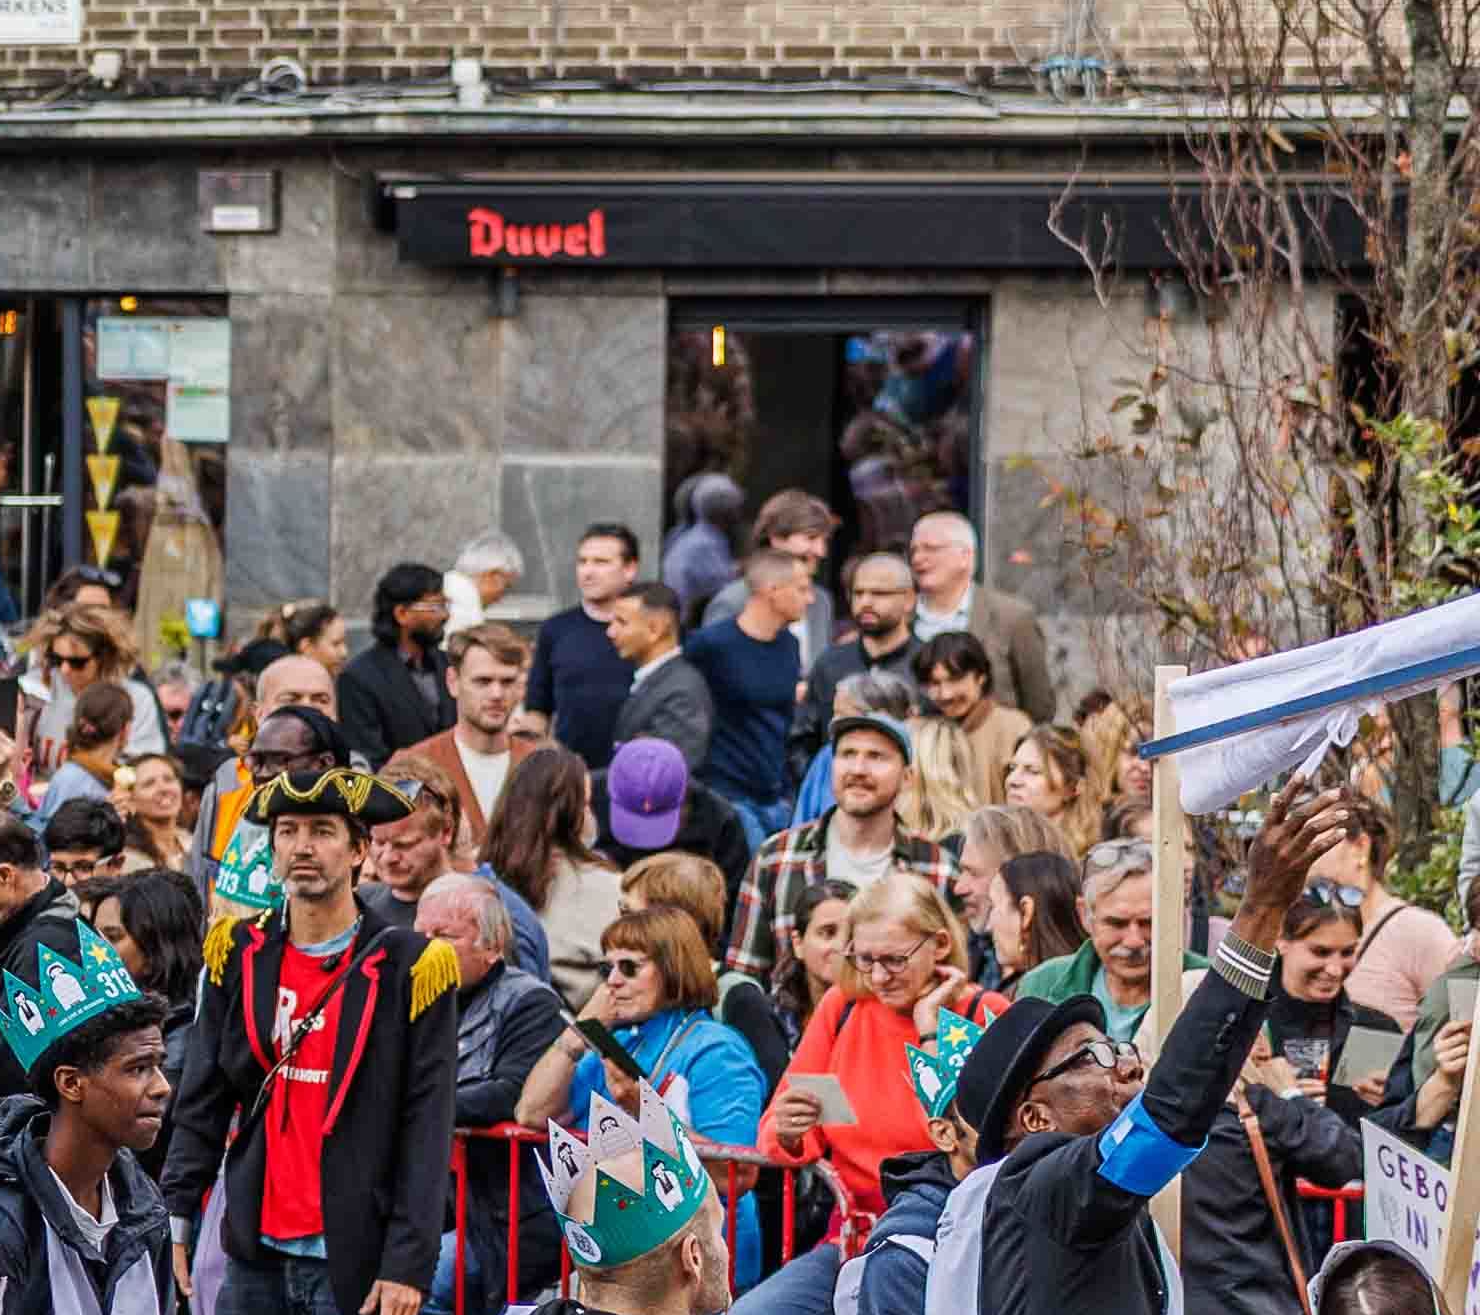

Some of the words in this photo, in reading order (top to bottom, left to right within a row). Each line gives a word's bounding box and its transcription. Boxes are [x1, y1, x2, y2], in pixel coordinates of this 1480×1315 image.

[468, 207, 607, 258] Duvel
[96, 967, 138, 998] 313
[1406, 1204, 1429, 1250] IN
